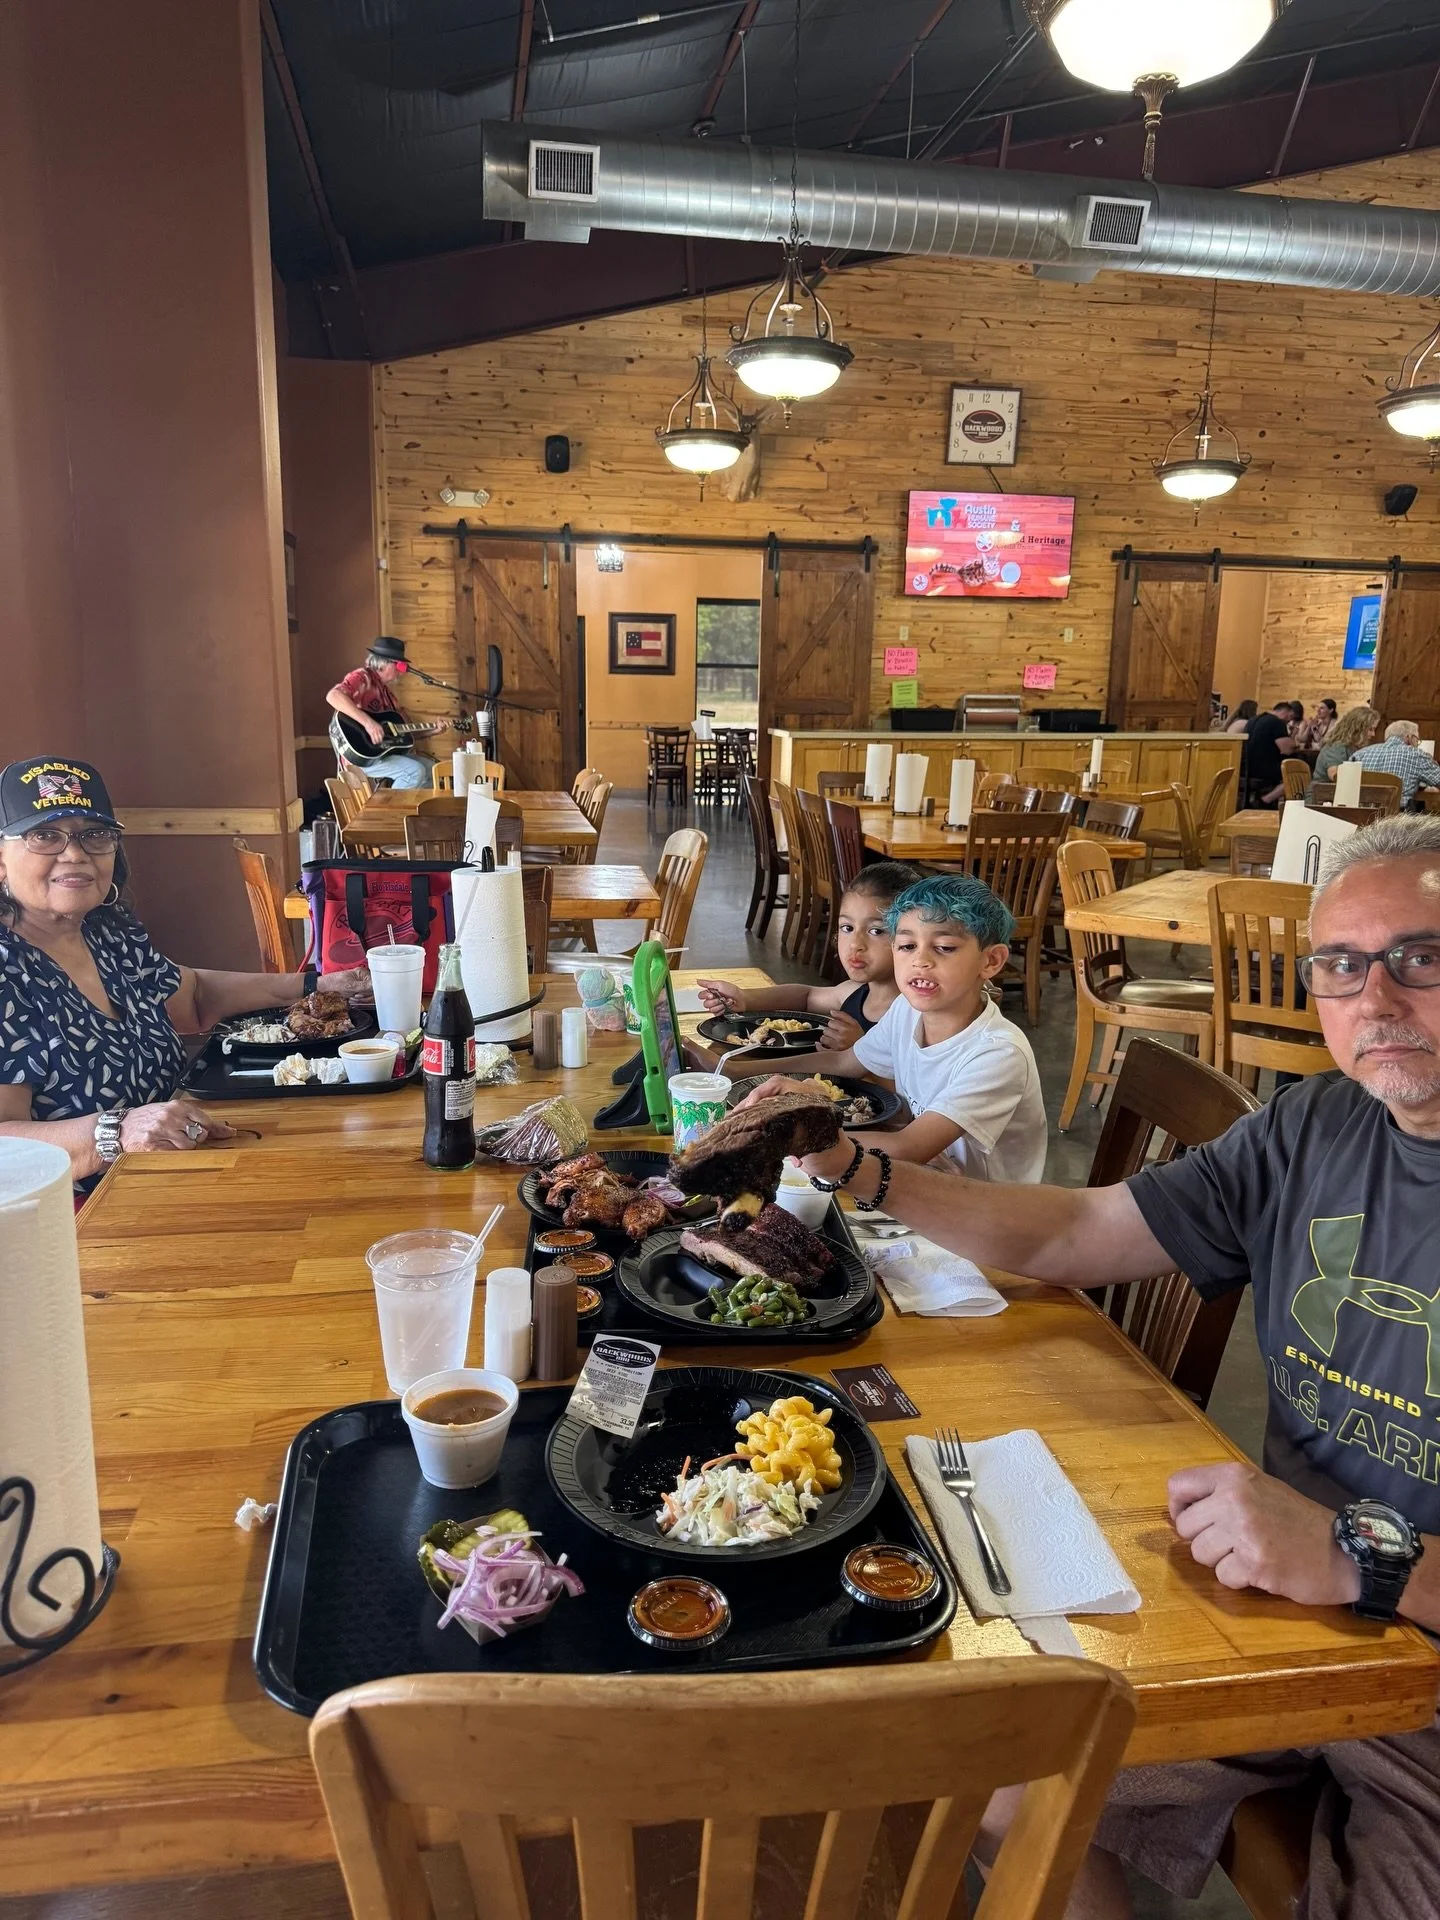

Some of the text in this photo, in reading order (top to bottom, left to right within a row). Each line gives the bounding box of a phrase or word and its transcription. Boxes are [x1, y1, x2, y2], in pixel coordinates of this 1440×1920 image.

[982, 394, 990, 403] 12
[956, 402, 964, 412] 10
[1008, 403, 1014, 413] 2
[955, 420, 961, 430] 9
[1007, 423, 1012, 432] 3
[954, 438, 960, 448] 8
[962, 450, 968, 460] 7
[978, 451, 984, 460] 6
[965, 504, 996, 514] Austin
[1028, 536, 1066, 545] Heritage
[20, 762, 90, 784] DISABLED
[32, 796, 92, 810] VETERAN
[596, 1346, 652, 1363] BACKWOODS
[1286, 1346, 1421, 1417] ESTABLISHED
[1270, 1356, 1328, 1432] U.S.
